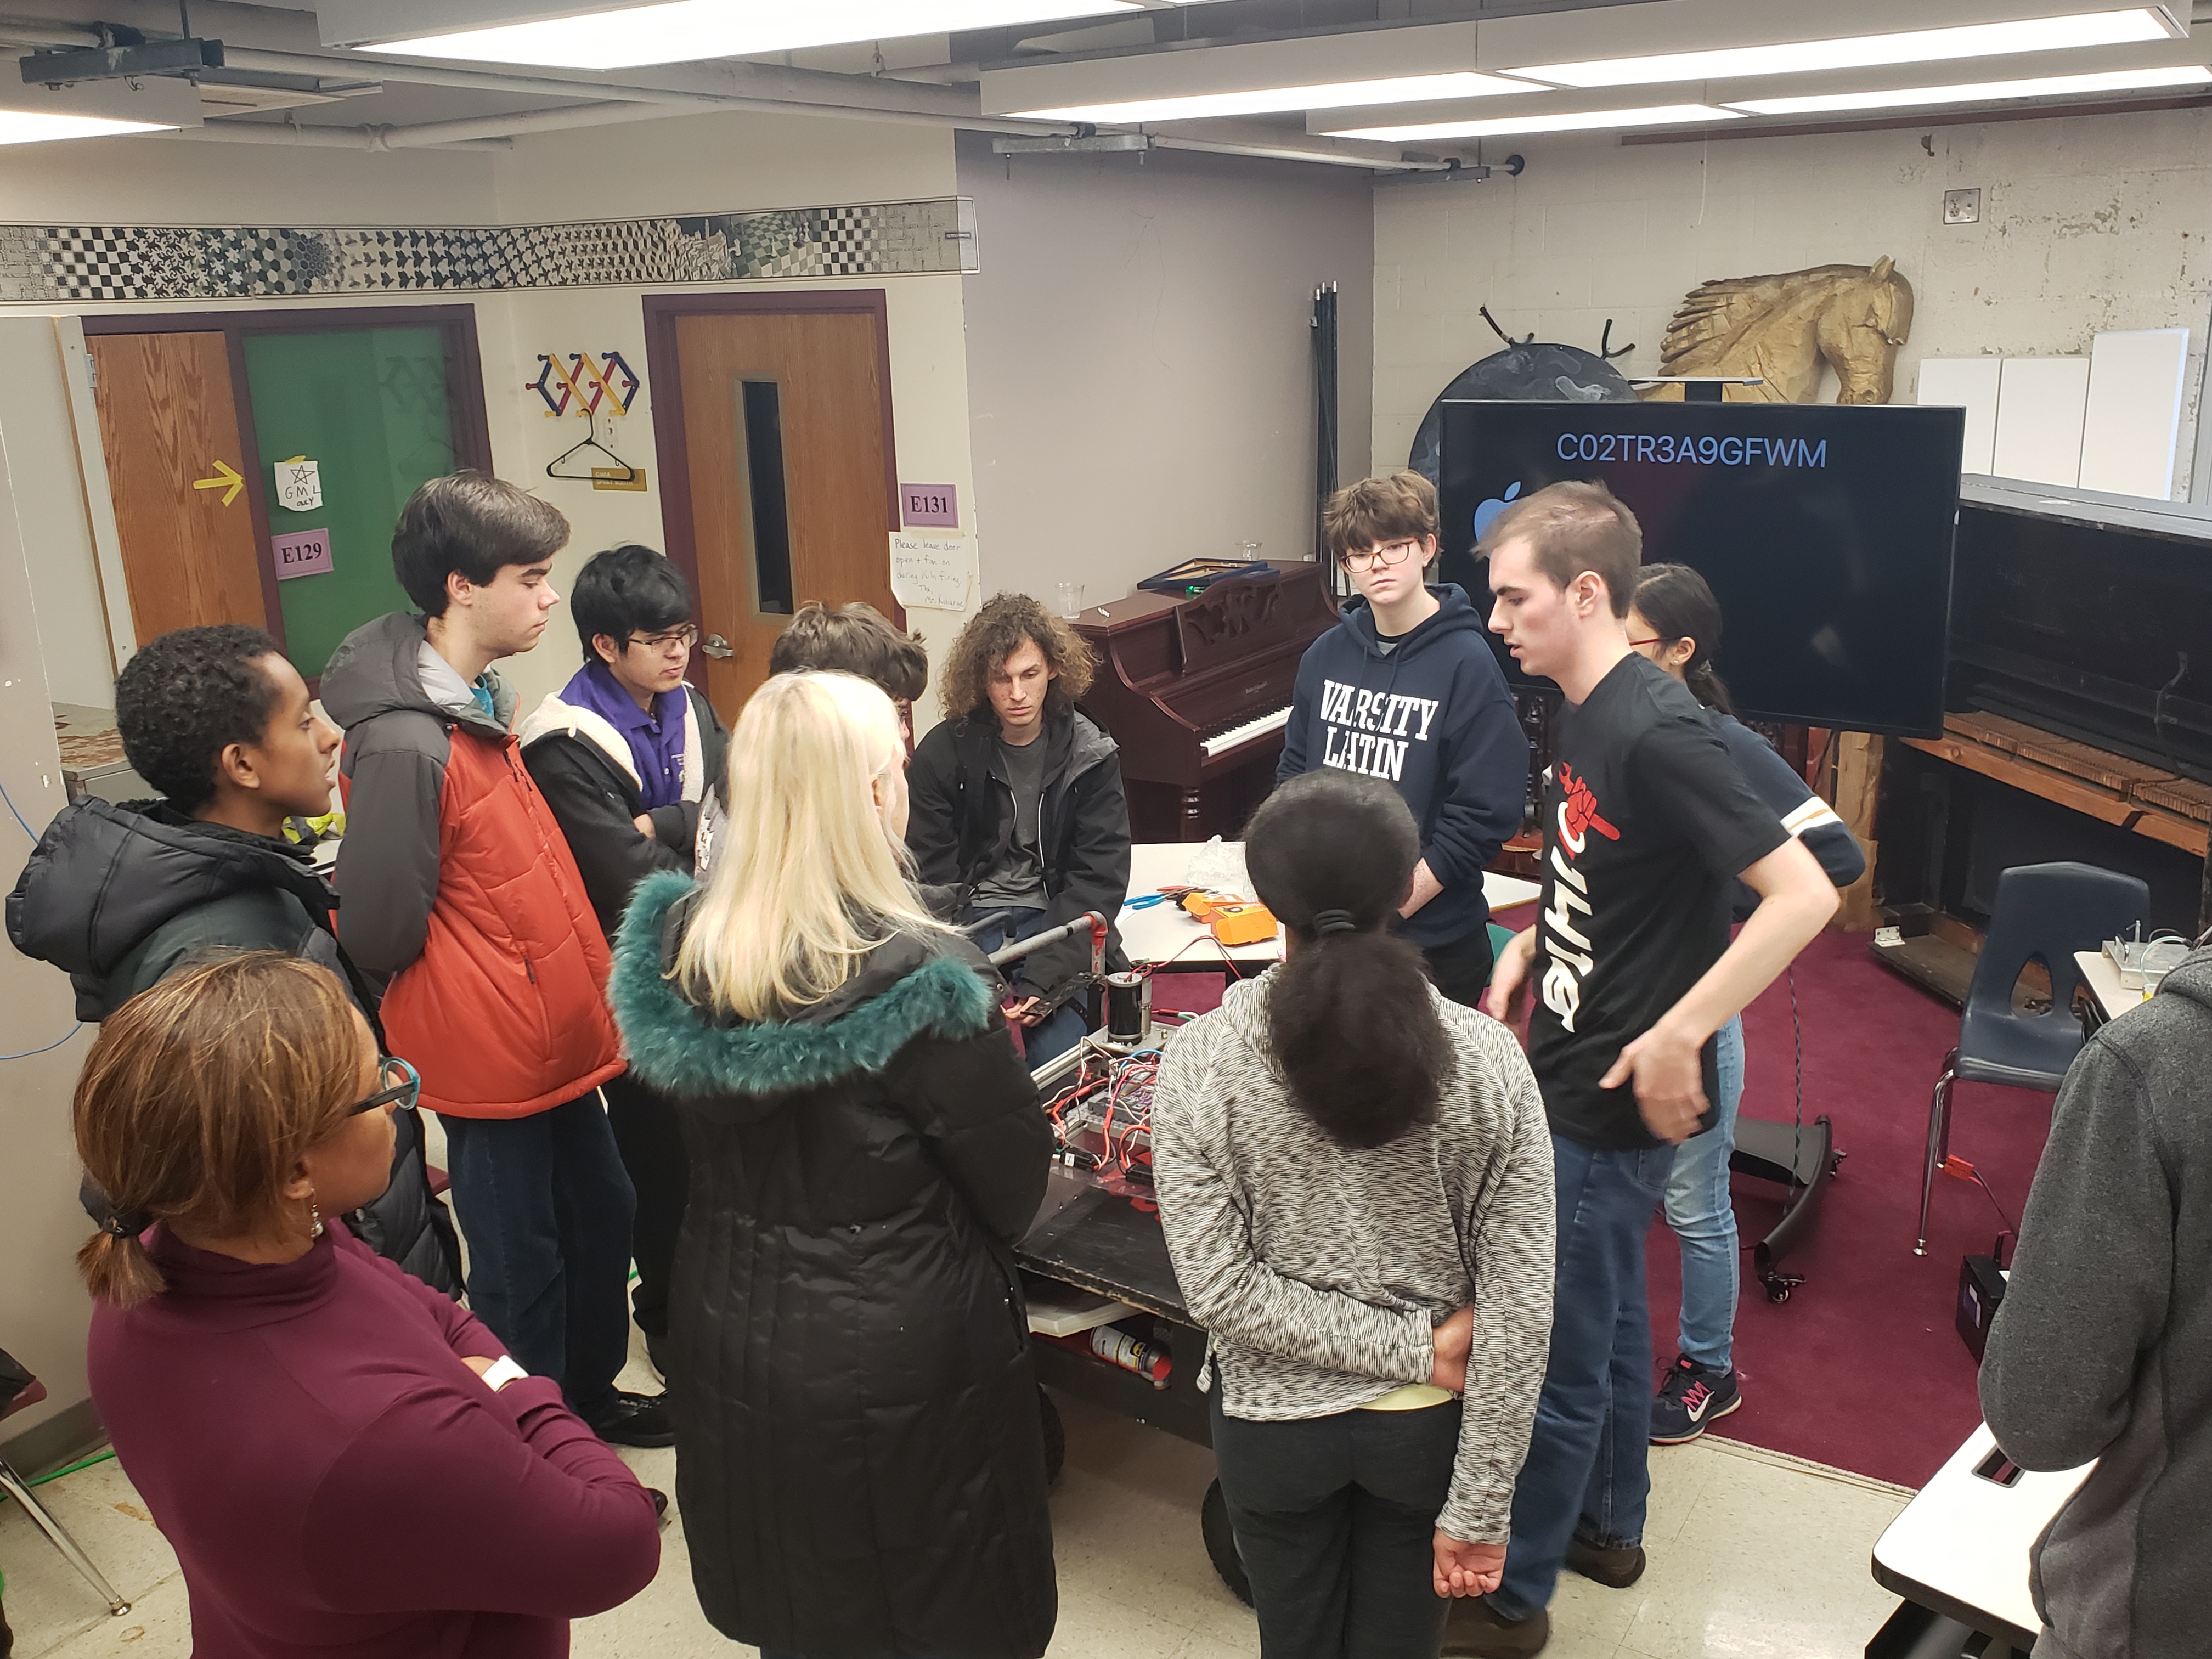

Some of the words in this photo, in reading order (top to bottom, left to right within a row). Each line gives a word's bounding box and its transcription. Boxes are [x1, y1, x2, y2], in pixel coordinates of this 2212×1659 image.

[1556, 433, 1827, 469] C02TR3A9GFWM
[910, 496, 949, 514] E131
[281, 542, 323, 564] E129
[895, 538, 919, 549] Please
[923, 538, 941, 550] leave
[944, 540, 961, 551] door
[896, 557, 913, 568] open
[924, 554, 938, 566] fan
[896, 571, 918, 585] during
[1320, 679, 1440, 741] VARSITY
[1322, 726, 1409, 782] LATIN
